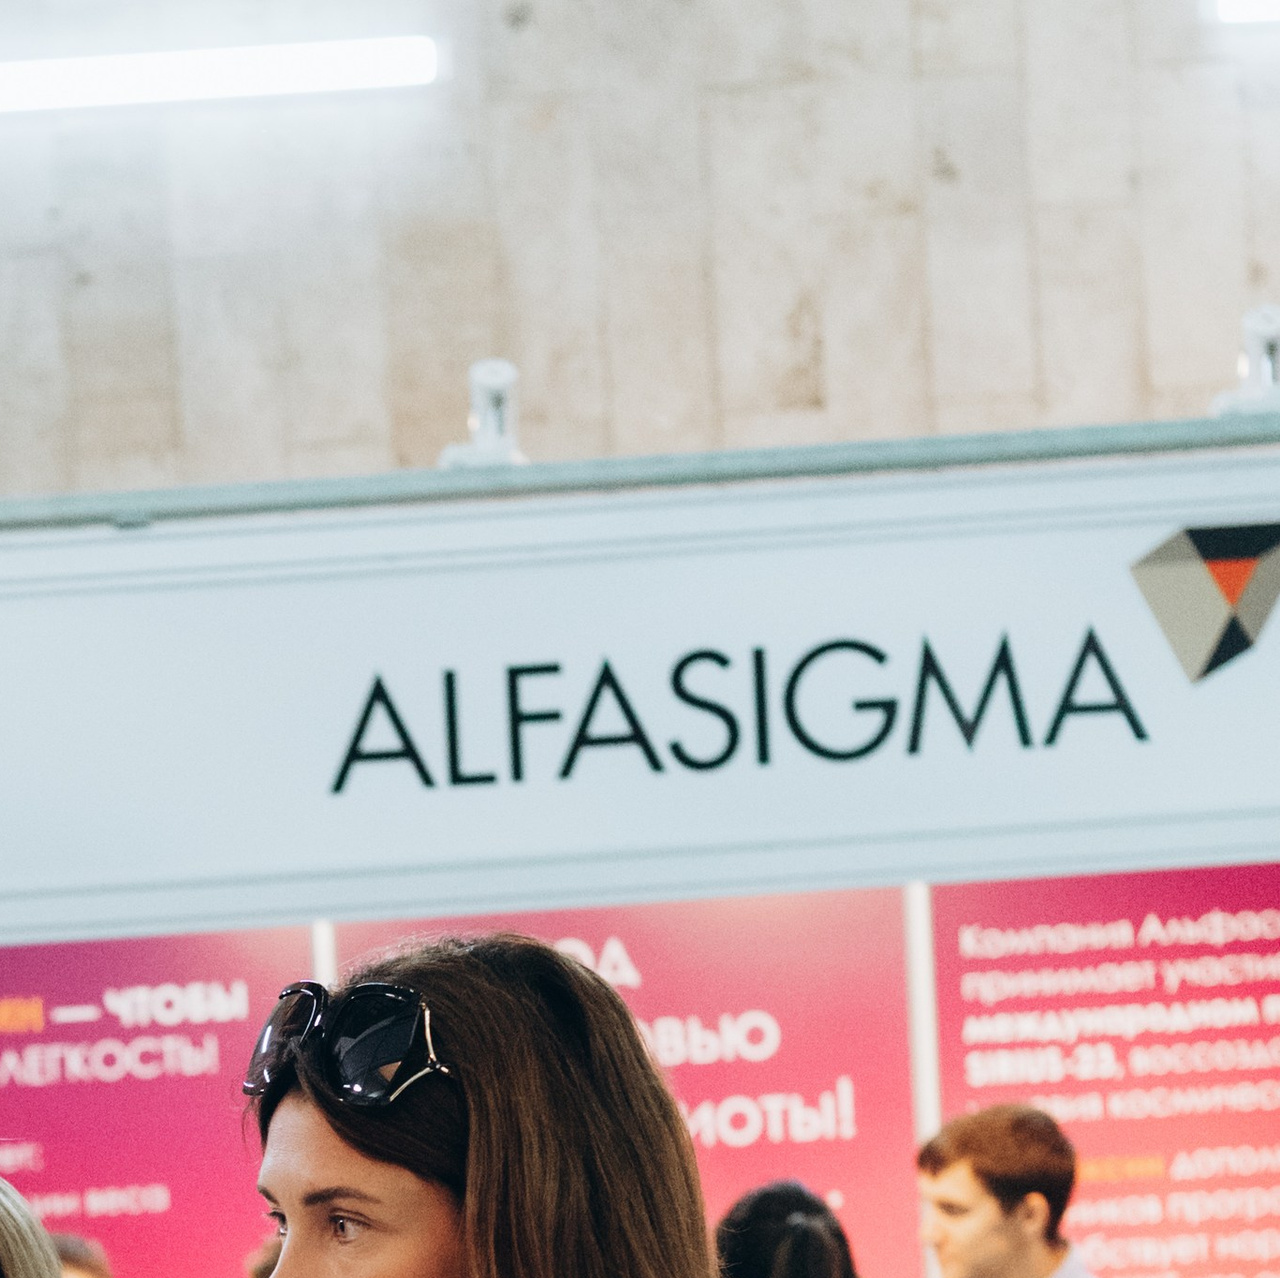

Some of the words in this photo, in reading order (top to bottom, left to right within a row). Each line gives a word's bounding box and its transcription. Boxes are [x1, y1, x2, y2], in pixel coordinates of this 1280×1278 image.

[331, 625, 1150, 794] ALFASIGMA
[958, 919, 1135, 959] Компания
[103, 979, 249, 1028] ЧТОБЫ
[960, 959, 1156, 1006] принимает
